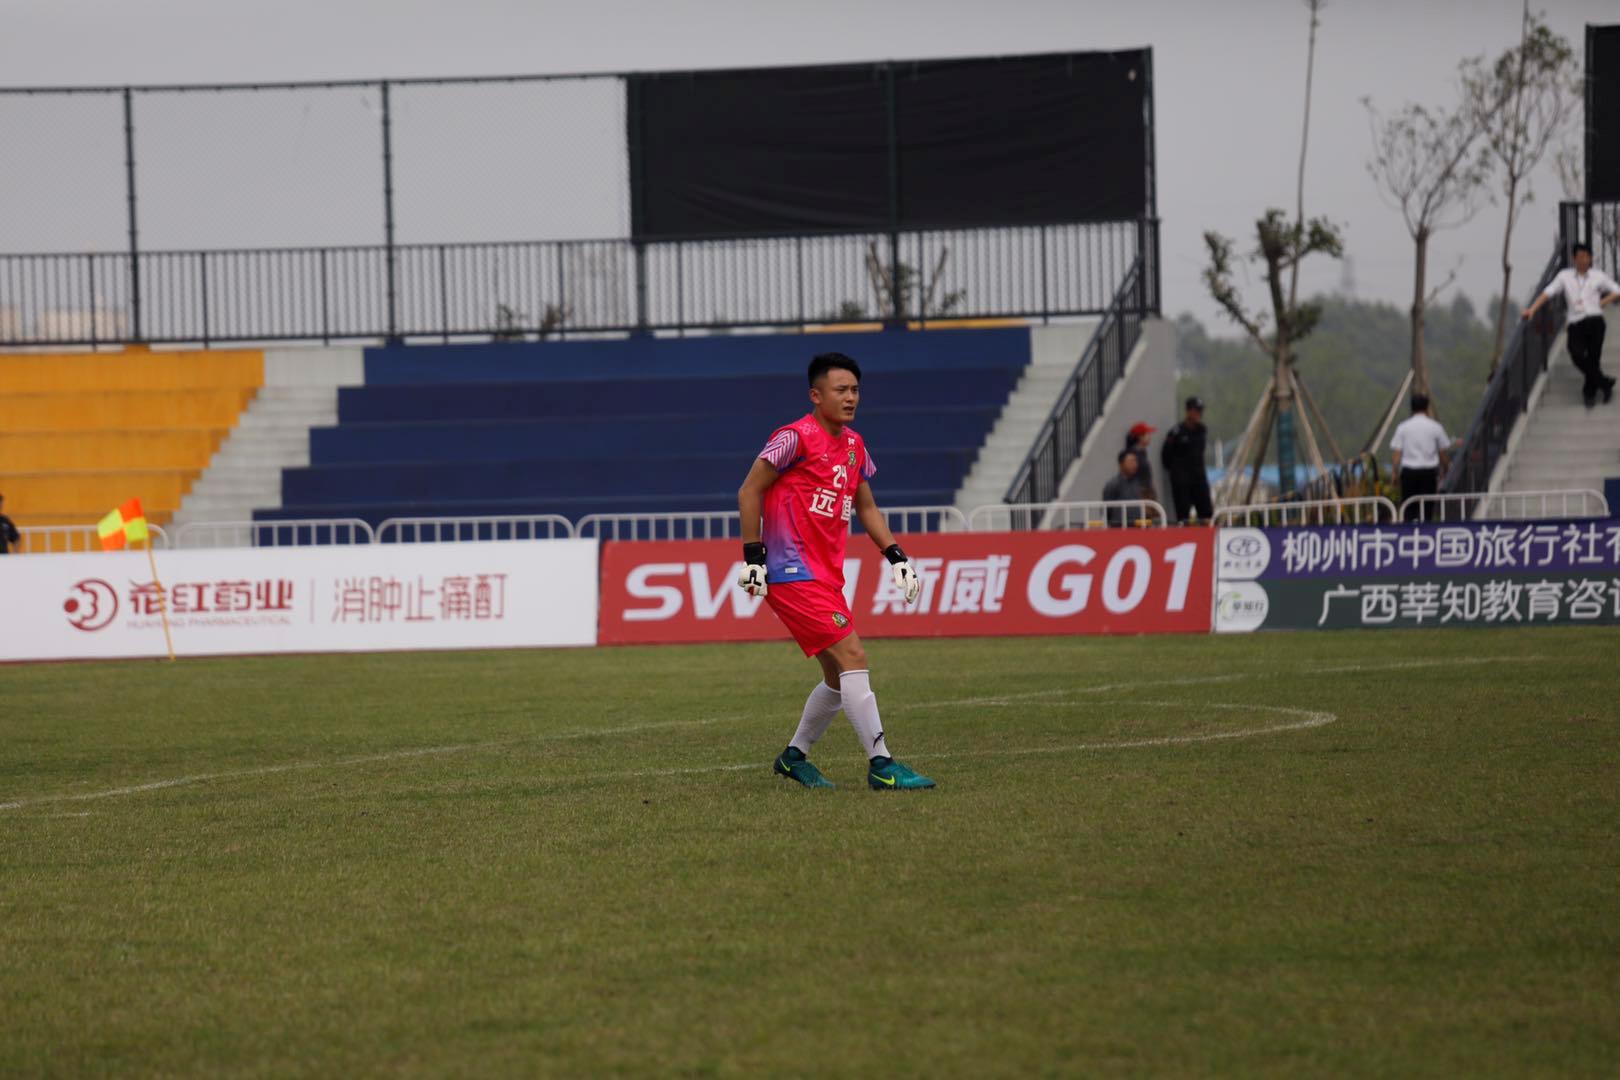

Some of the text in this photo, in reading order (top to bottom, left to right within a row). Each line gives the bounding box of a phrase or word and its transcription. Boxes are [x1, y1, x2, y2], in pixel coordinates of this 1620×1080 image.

[129, 578, 294, 615] 花红药业
[331, 573, 507, 623] 消肿止痛酊
[622, 542, 1198, 620] SW 斯威 G01
